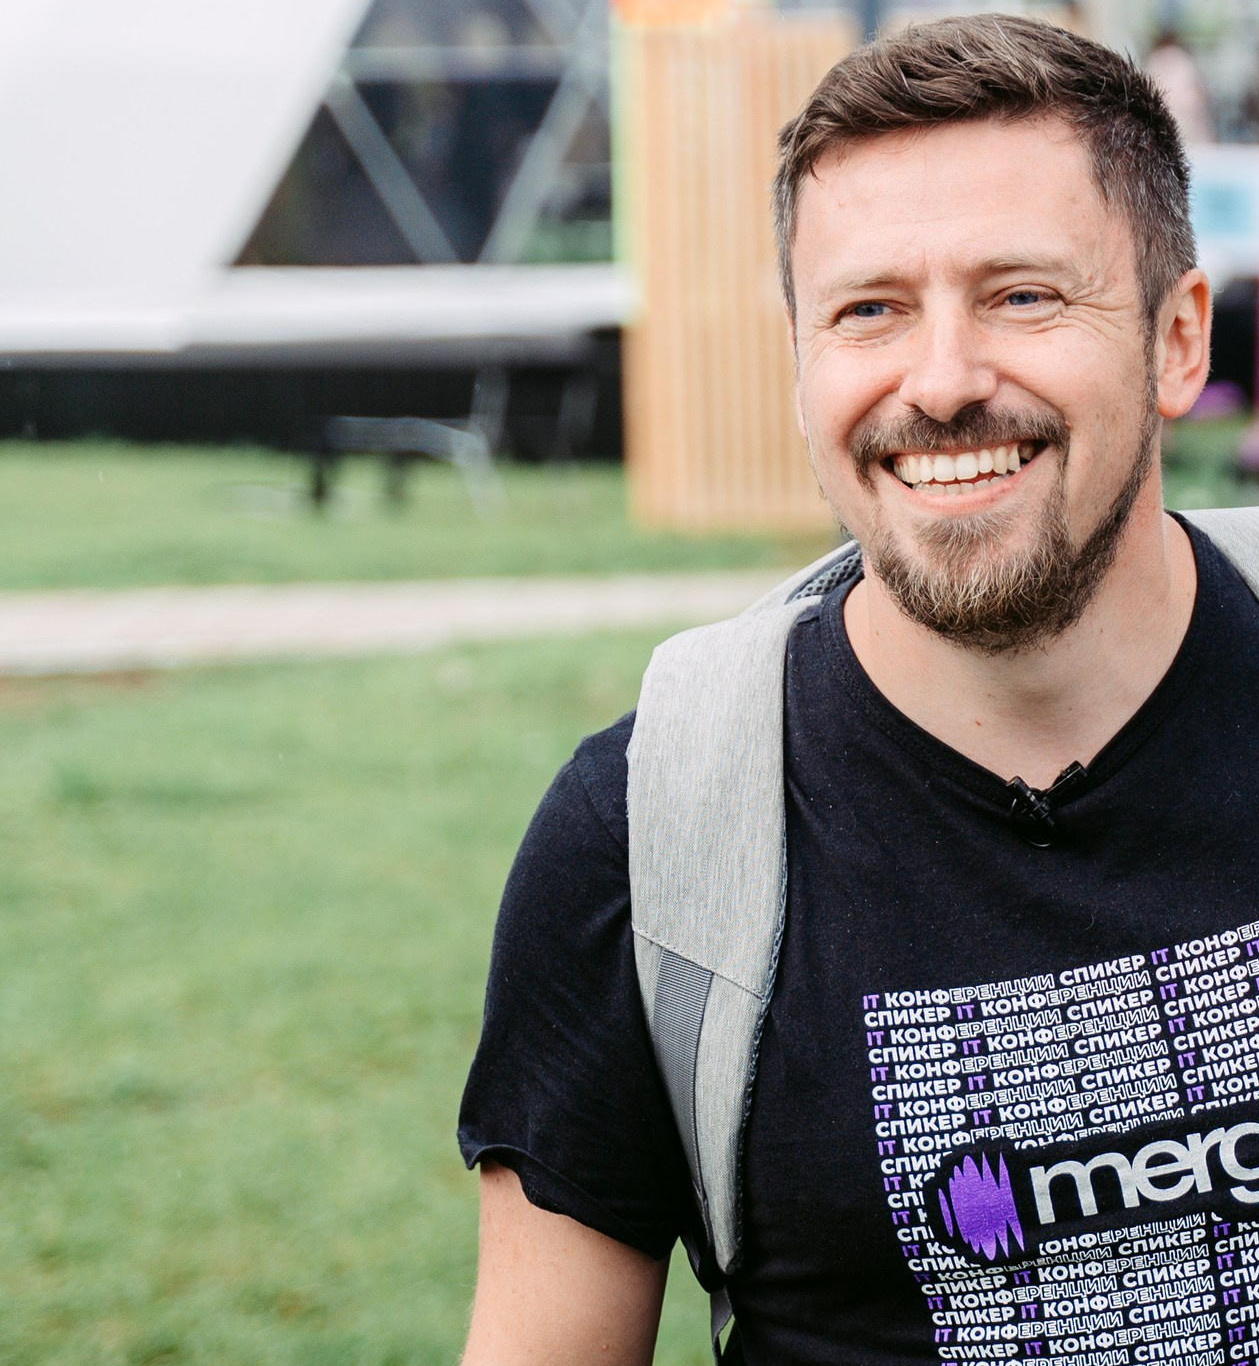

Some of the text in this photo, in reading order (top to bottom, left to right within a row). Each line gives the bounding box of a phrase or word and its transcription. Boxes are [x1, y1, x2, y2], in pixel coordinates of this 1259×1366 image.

[862, 994, 880, 1010] IT
[885, 973, 1055, 1008] КОНФЕРЕНЦИИ
[1059, 954, 1146, 986] СПИКЕР
[1150, 947, 1169, 966] IT
[864, 1006, 951, 1028] СПИКЕР
[956, 1004, 975, 1020] IT
[980, 970, 1151, 1016] КОНФЕРЕНЦИИ
[1155, 946, 1241, 982] СПИКЕР
[866, 1030, 885, 1047] IT
[890, 1008, 1062, 1044] КОНФЕРЕНЦИИ
[1066, 989, 1154, 1021] СПИКЕР
[1159, 982, 1178, 1000] IT
[868, 1042, 957, 1064] СПИКЕР
[962, 1039, 981, 1055] IT
[986, 1005, 1160, 1052] КОНФЕРЕНЦИИ
[1164, 981, 1250, 1017] СПИКЕР
[870, 1066, 889, 1082] IT
[894, 1042, 1069, 1080] КОНФЕРЕНЦИИ
[1074, 1023, 1162, 1055] СПИКЕР
[1167, 1016, 1186, 1034] IT
[871, 1078, 961, 1101] СПИКЕР
[967, 1075, 987, 1091] IT
[993, 1039, 1169, 1087] КОНФЕРЕНЦИИ
[1173, 1016, 1259, 1051] СПИКЕР
[873, 1103, 893, 1120] IT
[898, 1078, 1076, 1117] КОНФЕРЕНЦИИ
[1081, 1057, 1171, 1090] СПИКЕР
[1177, 1051, 1196, 1069] IT
[875, 1113, 966, 1138] СПИКЕР
[972, 1109, 992, 1126] IT
[998, 1073, 1177, 1122] КОНФЕРЕНЦИИ
[877, 1139, 896, 1156] IT
[1089, 1091, 1180, 1124] СПИКЕР
[1186, 1085, 1205, 1103] IT
[880, 1150, 953, 1175] СПИК
[883, 1175, 902, 1192] IT
[891, 1210, 910, 1225] IT
[1118, 1228, 1206, 1255] СПИКЕР
[1213, 1222, 1231, 1237] IT
[902, 1244, 920, 1257] IT
[908, 1255, 980, 1272] СПИК
[921, 1275, 1007, 1295] СПИКЕР
[1013, 1270, 1031, 1285] IT
[1038, 1244, 1209, 1286] КОНФЕРЕНЦИИ
[927, 1296, 944, 1310] IT
[949, 1275, 1118, 1309] КОНФЕРЕНЦИИ
[1122, 1259, 1211, 1288] СПИКЕР
[1216, 1253, 1234, 1270] IT
[932, 1306, 1015, 1326] СПИКЕР
[1020, 1303, 1038, 1320] IT
[1043, 1275, 1215, 1318] КОНФЕРЕНЦИИ
[934, 1328, 953, 1343] IT
[956, 1311, 1124, 1342] КОНФЕРЕНЦИИ
[1128, 1294, 1216, 1324] СПИКЕР
[1222, 1288, 1241, 1306] IT
[938, 1343, 1019, 1359] СПИКЕР
[1024, 1341, 1043, 1356] IT
[1048, 1312, 1221, 1354] КОНФЕРЕНЦИИ
[1134, 1332, 1222, 1362] СПИКЕР
[1228, 1326, 1246, 1343] IT
